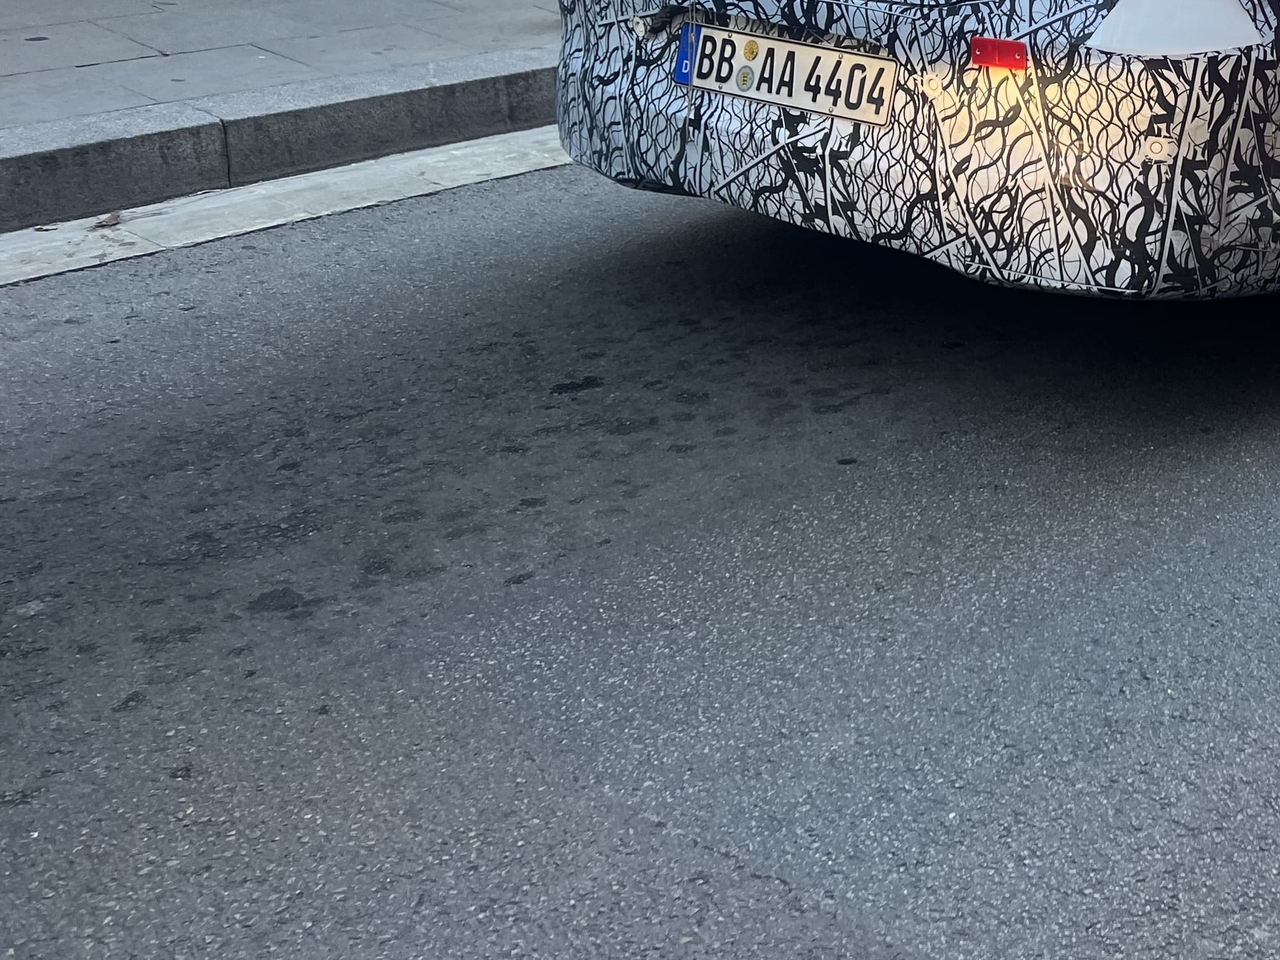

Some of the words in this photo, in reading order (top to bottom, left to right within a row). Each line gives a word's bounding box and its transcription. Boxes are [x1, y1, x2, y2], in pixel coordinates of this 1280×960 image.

[696, 35, 736, 84] BB
[755, 47, 795, 97] AA
[804, 55, 885, 115] 4404
